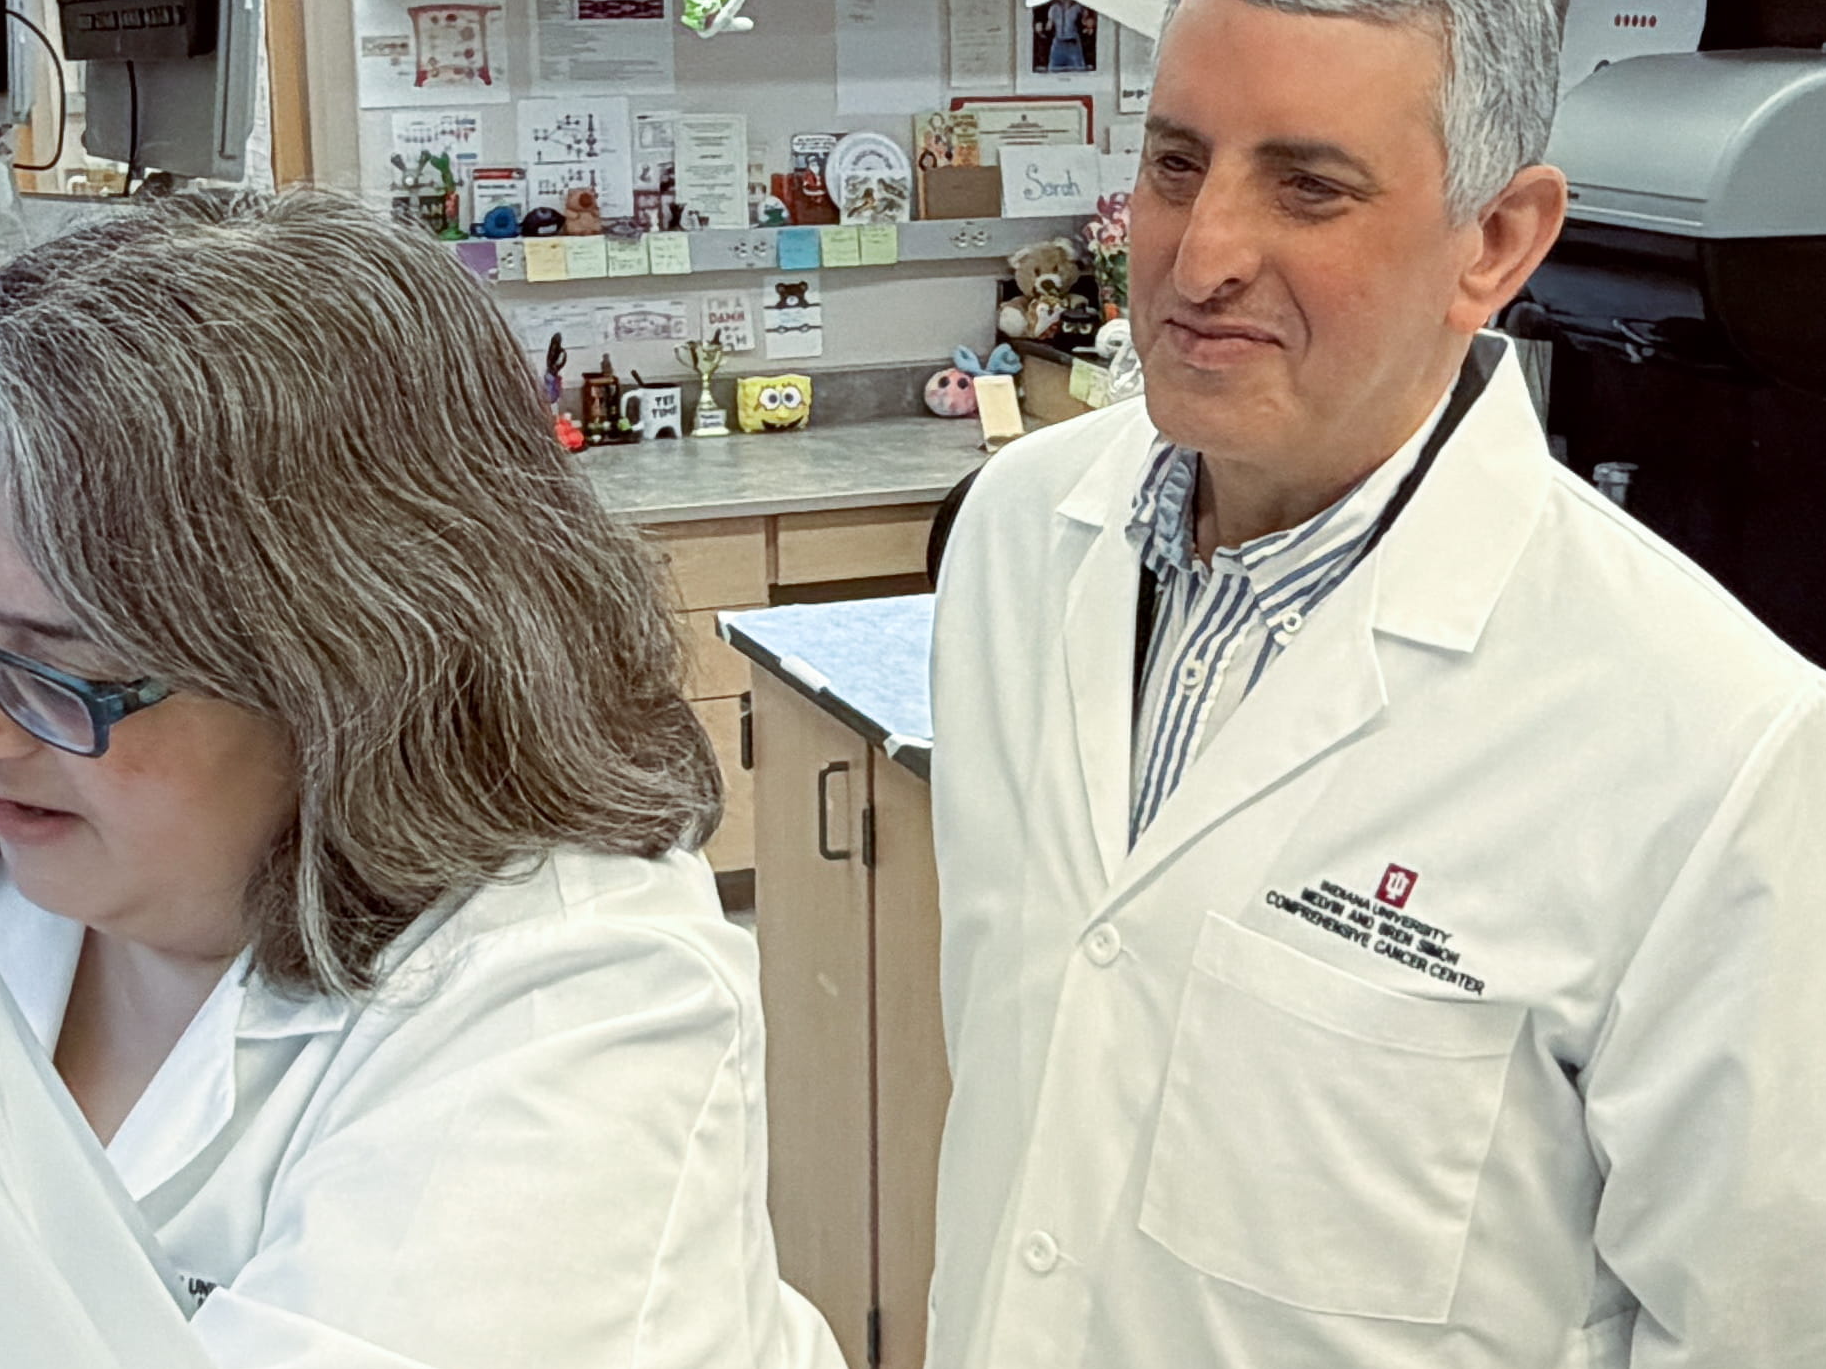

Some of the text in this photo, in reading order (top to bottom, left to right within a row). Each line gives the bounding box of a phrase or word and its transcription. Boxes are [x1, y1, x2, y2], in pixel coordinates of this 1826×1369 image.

[1023, 163, 1082, 201] Sarah
[1266, 890, 1486, 996] COMPREHENSIVE CANCER CENTER
[1301, 887, 1461, 966] MELVIN AND BREN SIMON
[1320, 879, 1453, 944] INDIANA UNIVERSITY
